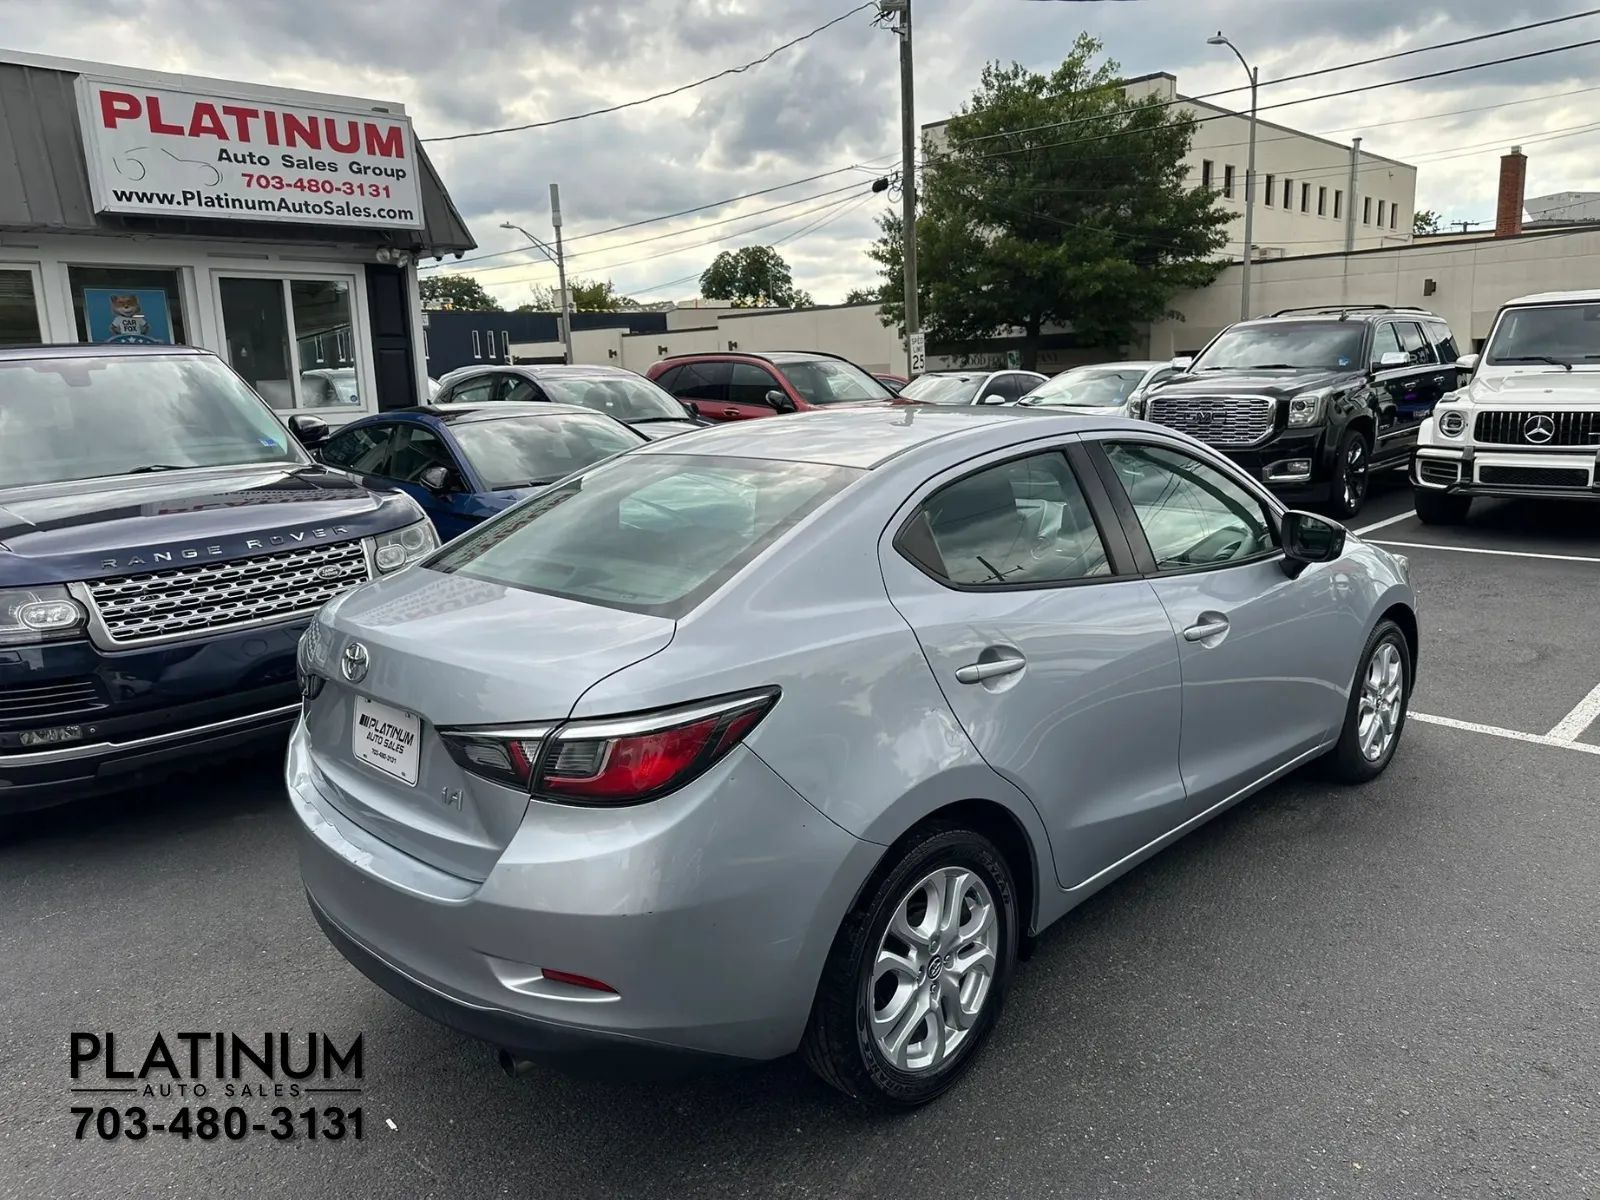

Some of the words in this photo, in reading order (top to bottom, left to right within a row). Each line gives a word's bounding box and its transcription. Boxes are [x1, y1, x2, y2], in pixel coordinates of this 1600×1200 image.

[99, 90, 405, 159] PLATINUM
[217, 148, 270, 167] Auto
[281, 154, 339, 173] Sales
[348, 161, 407, 181] Group
[241, 173, 391, 199] 703-480-3131
[112, 189, 414, 220] www.PlatinumAutoSales.com
[912, 354, 925, 370] 25
[1184, 411, 1227, 424] GMC
[101, 545, 223, 569] RANGE
[245, 526, 348, 549] ROVER
[366, 731, 383, 745] AUTO
[383, 738, 405, 754] SALES
[368, 717, 415, 746] PLATINUM
